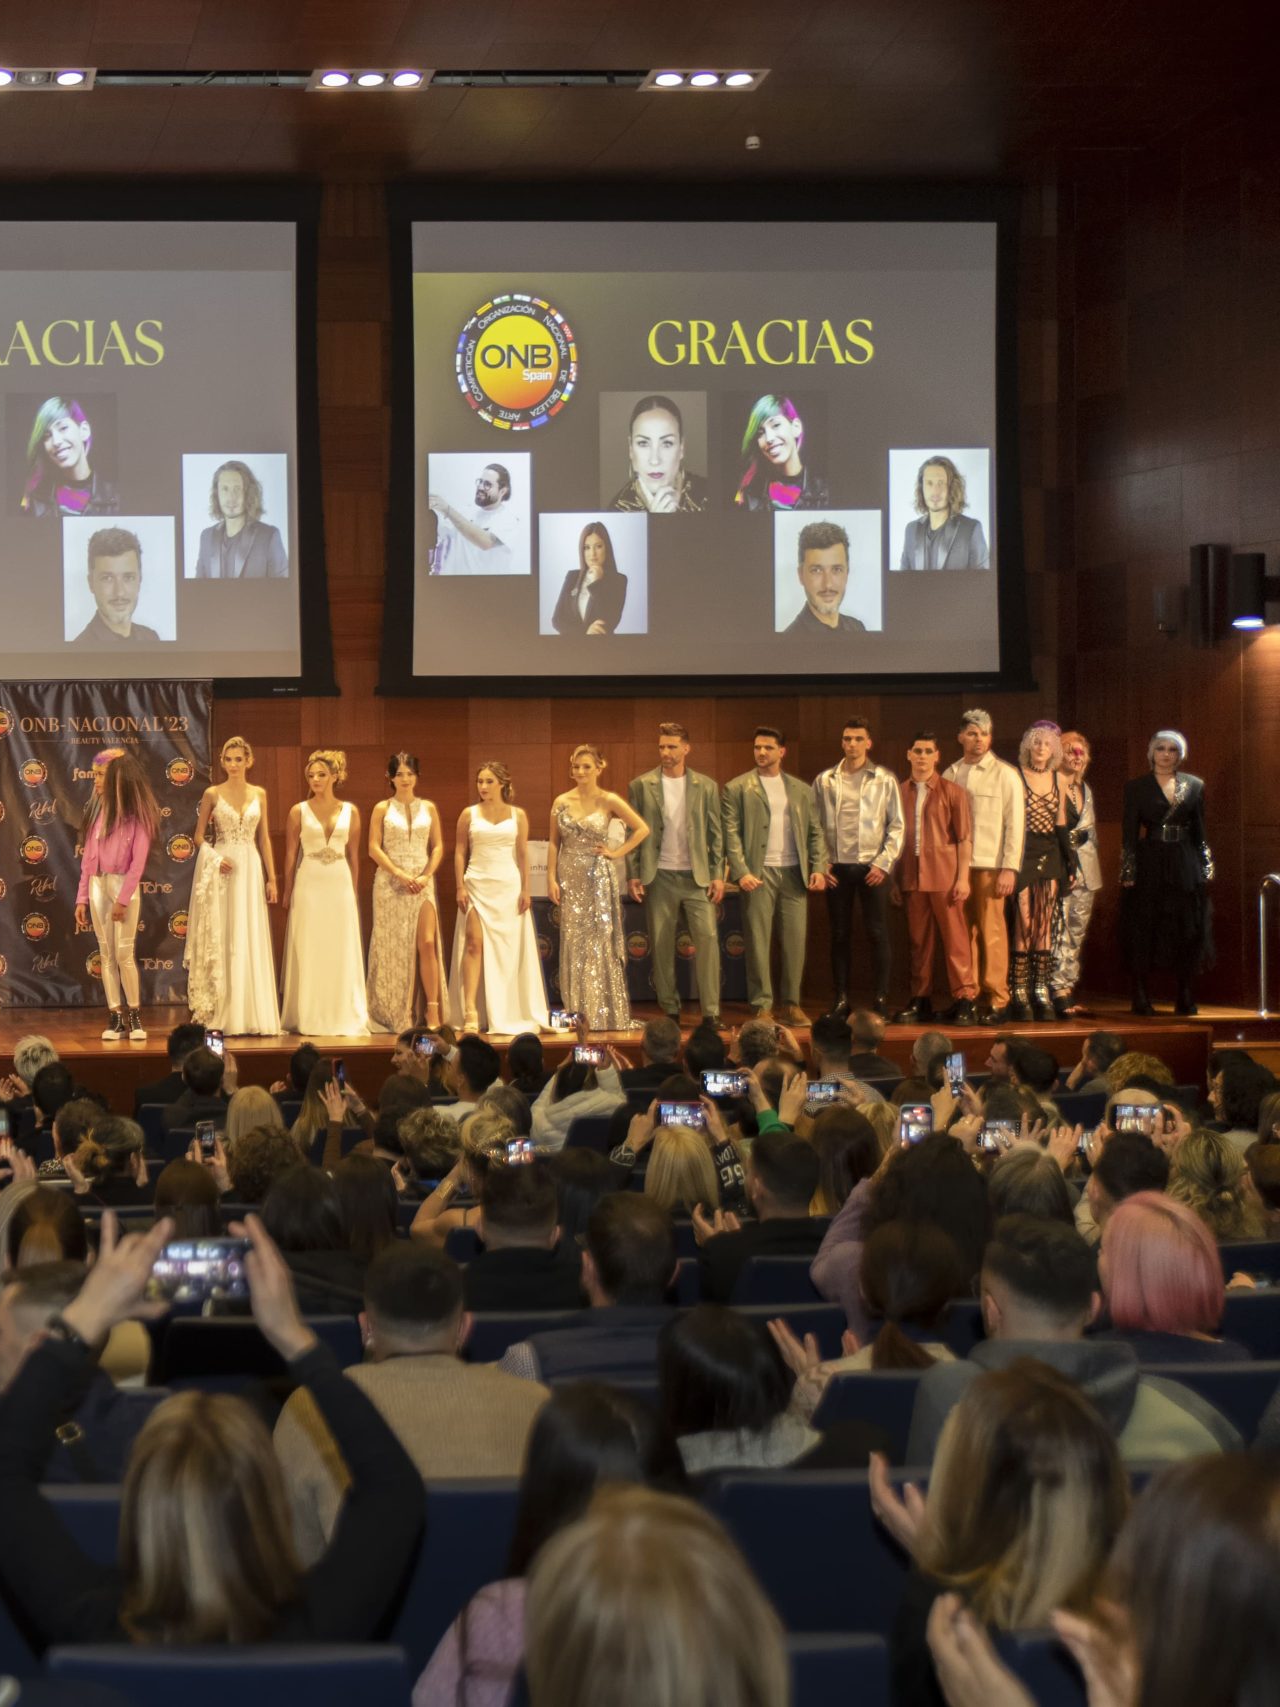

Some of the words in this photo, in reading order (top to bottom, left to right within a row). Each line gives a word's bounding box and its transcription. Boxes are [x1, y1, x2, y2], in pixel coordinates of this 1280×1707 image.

[477, 305, 536, 329] ORGANIZACIÓN
[543, 315, 568, 359] NACIONAL
[647, 319, 874, 366] GRACIAS
[480, 344, 553, 369] ONB
[522, 369, 552, 383] Spain
[559, 370, 568, 383] DE
[529, 389, 562, 417] BELLEZA
[498, 410, 521, 421] ARTE
[71, 737, 100, 745] BEAUTY
[102, 736, 139, 745] VALENCIA
[140, 958, 173, 971] Tahe
